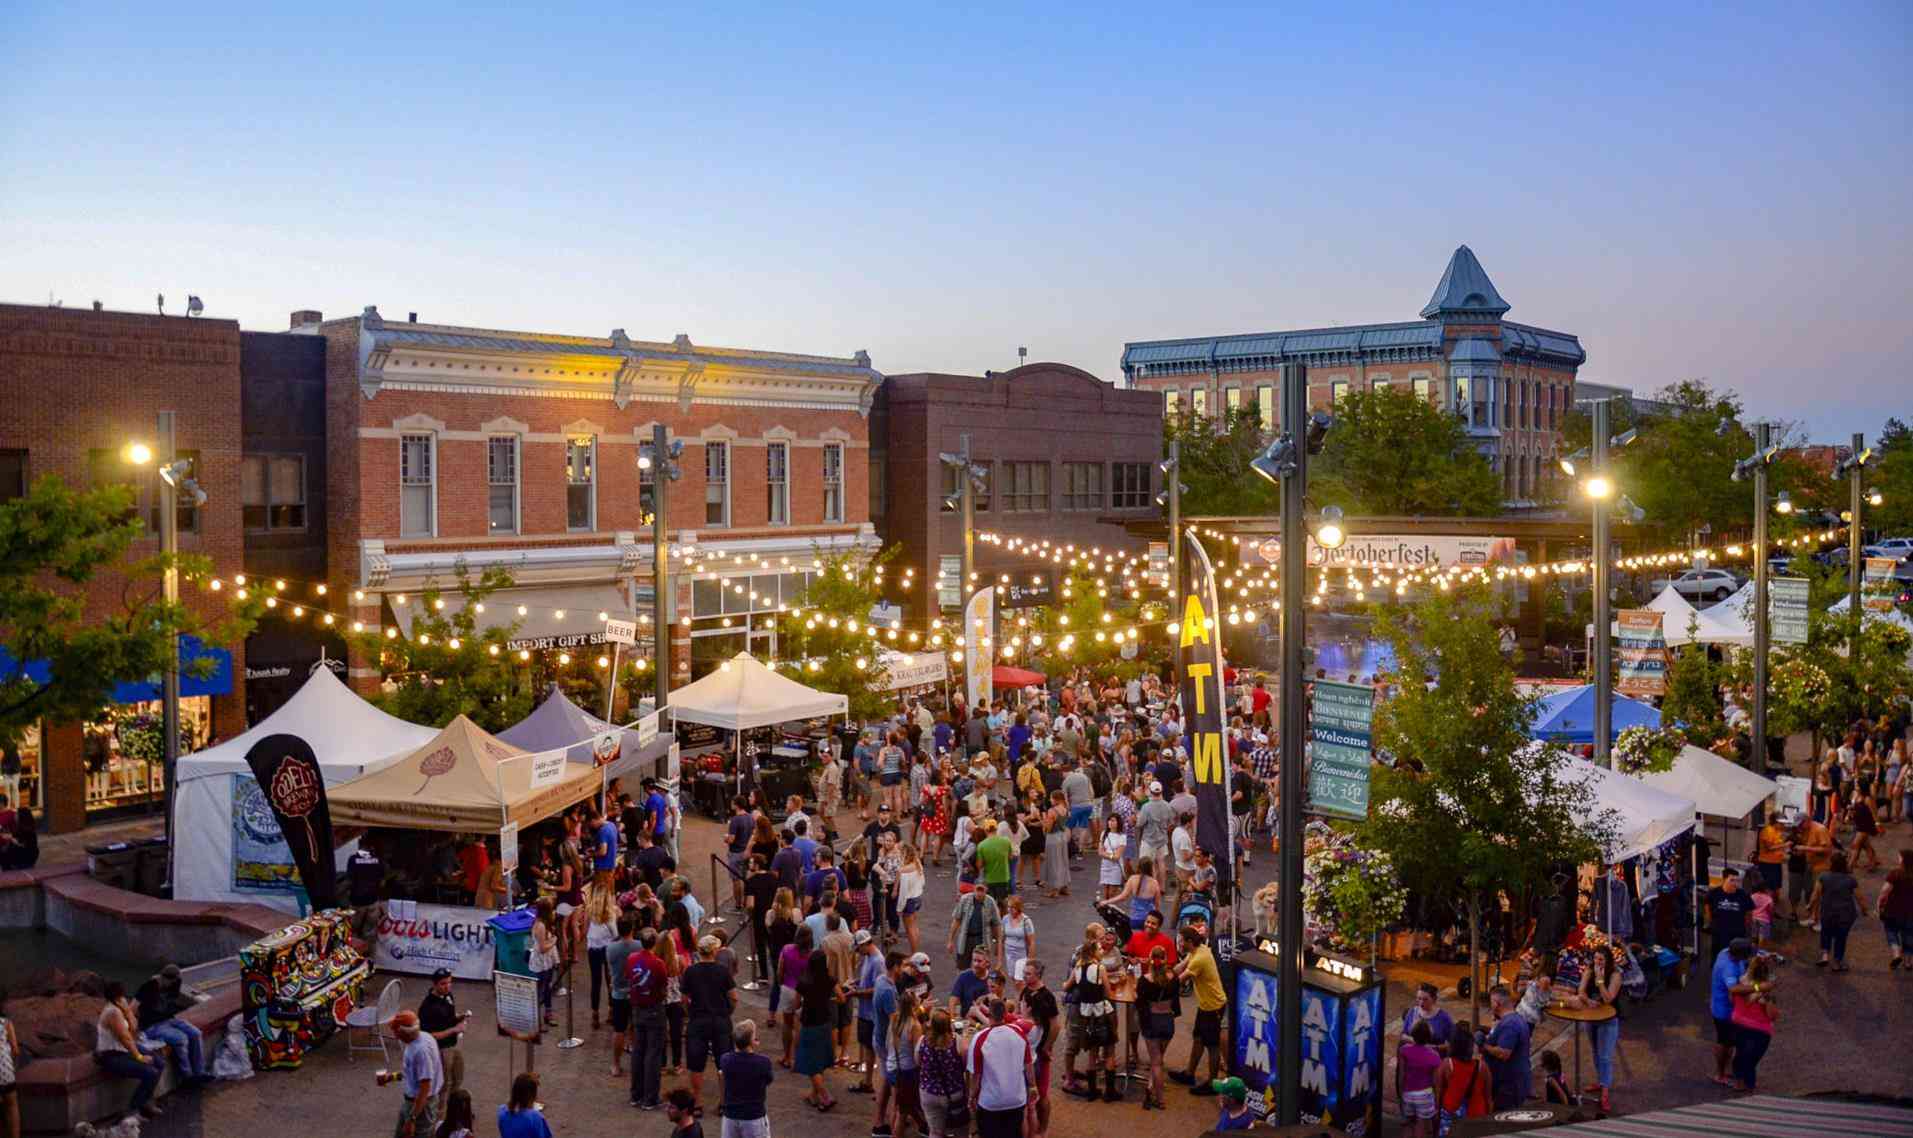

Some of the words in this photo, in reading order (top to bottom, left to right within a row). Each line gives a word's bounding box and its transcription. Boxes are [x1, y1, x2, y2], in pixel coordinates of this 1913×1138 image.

[558, 634, 587, 647] GIFT
[607, 624, 633, 638] BEER
[1314, 729, 1368, 748] Welcome
[433, 921, 494, 945] LIGHT
[1259, 939, 1279, 955] AT
[1315, 957, 1362, 982] ATM
[1245, 979, 1271, 1074] ATM
[1300, 997, 1328, 1097] ATM
[1350, 999, 1372, 1098] ATM
